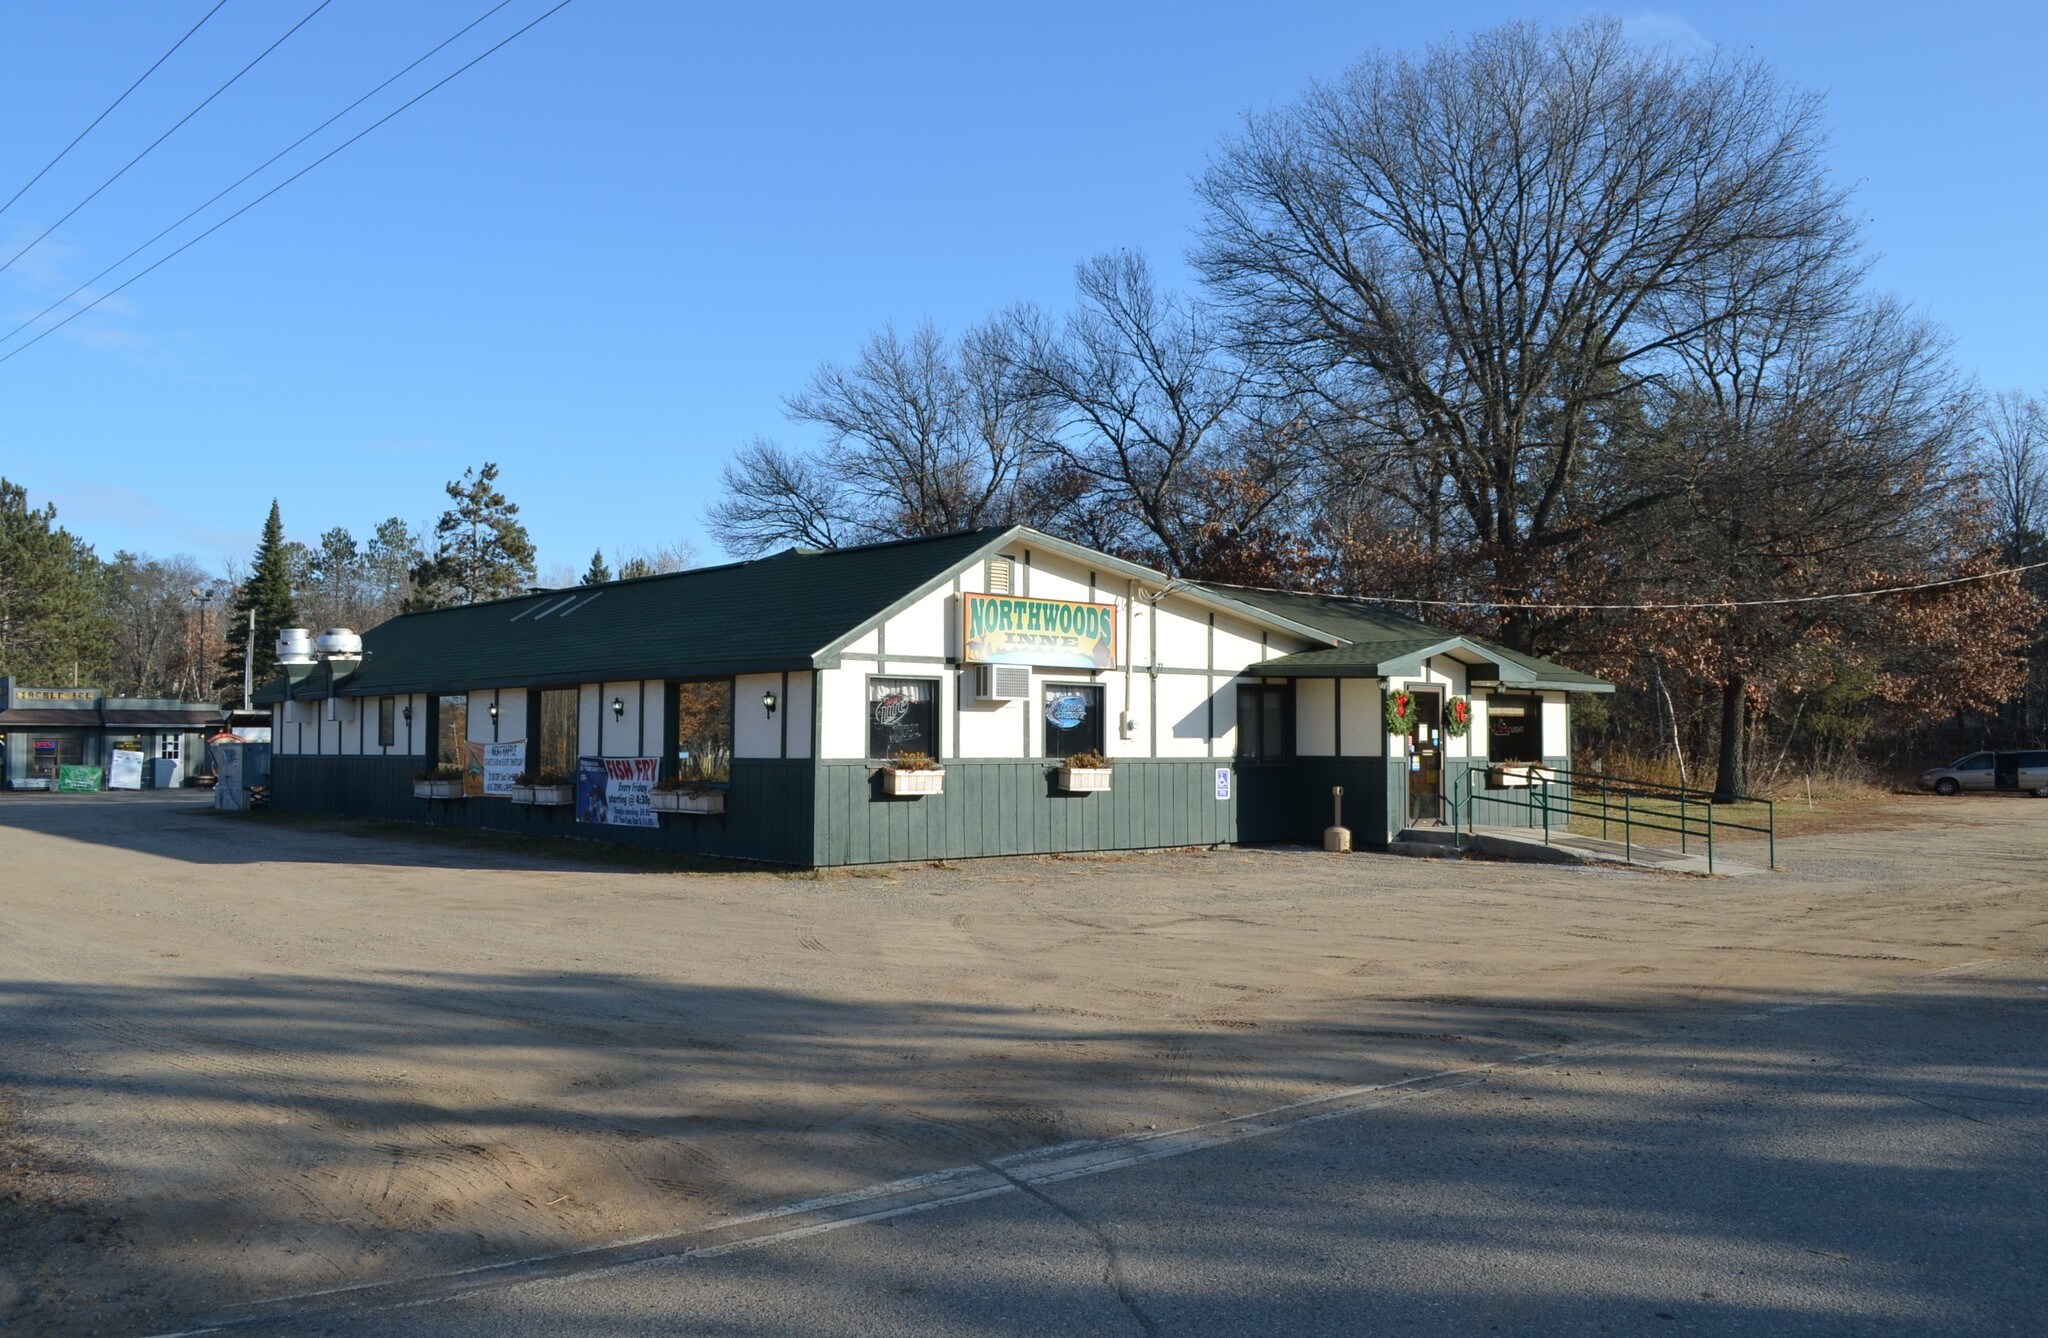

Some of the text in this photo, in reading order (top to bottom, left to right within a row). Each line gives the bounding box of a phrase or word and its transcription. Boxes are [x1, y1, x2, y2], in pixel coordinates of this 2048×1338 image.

[970, 598, 1111, 646] NORTHWOODS
[1004, 632, 1079, 648] INNE
[605, 759, 658, 782] FISH FRY
[618, 781, 648, 795] Every Friday
[608, 794, 628, 806] starting
[628, 794, 635, 806] @
